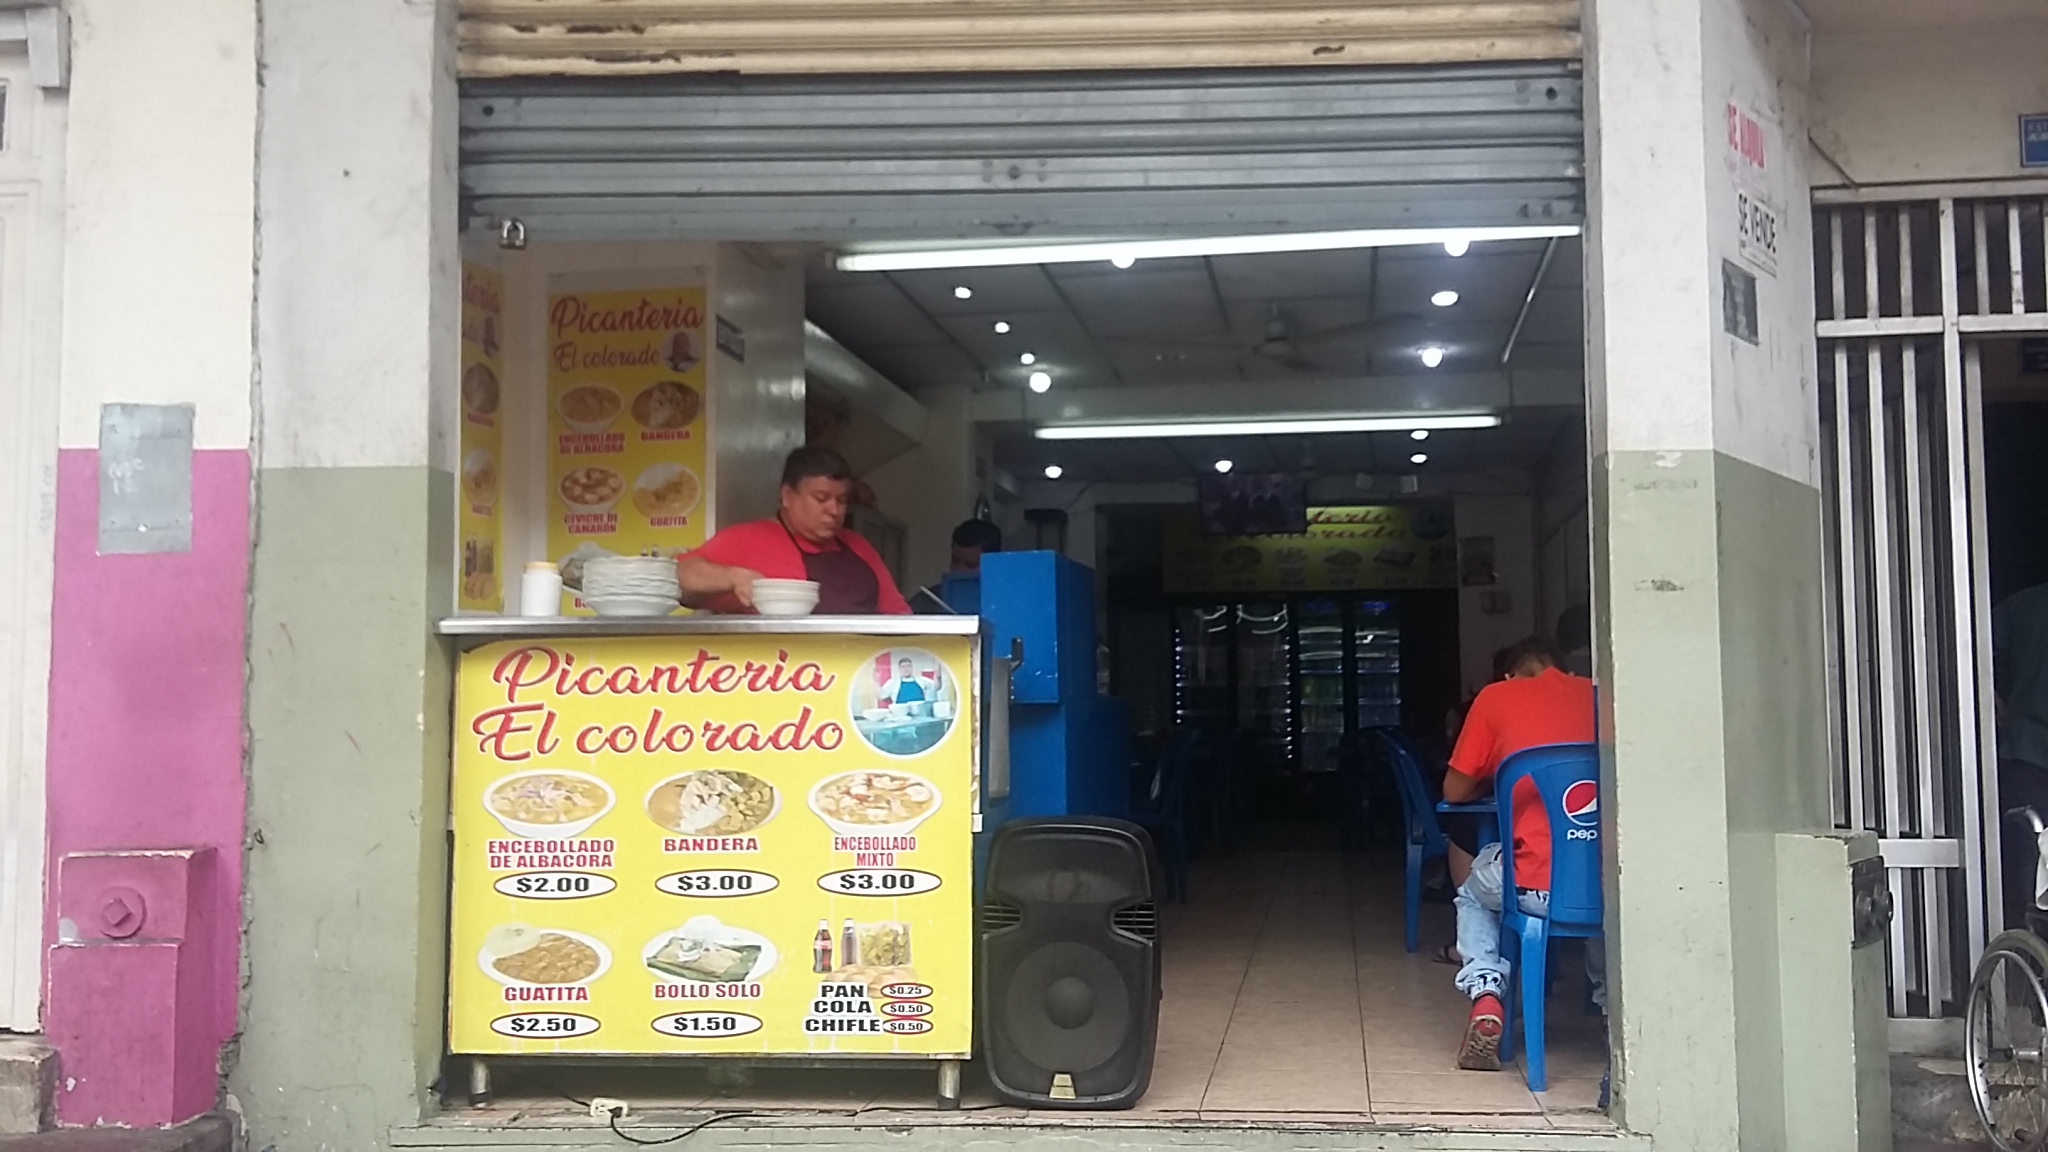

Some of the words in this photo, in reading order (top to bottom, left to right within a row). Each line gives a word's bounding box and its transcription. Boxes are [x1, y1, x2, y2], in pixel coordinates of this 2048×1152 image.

[1738, 193, 1749, 236] SE
[1750, 200, 1777, 254] VENDE
[551, 295, 703, 339] Picanteria
[553, 341, 578, 372] El
[582, 341, 661, 369] colorado
[492, 645, 836, 703] Picanteria
[471, 702, 560, 761] El
[576, 706, 844, 755] colorado
[487, 839, 615, 854] ENCEBOLLADO
[663, 837, 759, 851] BANDERA
[834, 836, 916, 851] ENCEBOLLADO
[489, 854, 514, 868] DE
[516, 854, 613, 868] ALBACORA
[856, 852, 895, 867] MIXTO
[516, 876, 590, 893] $2.00
[677, 873, 753, 892] $3.00
[840, 872, 915, 891] $3.00
[504, 986, 589, 1001] GUATITA
[654, 983, 710, 998] BOLLO
[715, 983, 761, 998] SOLO
[821, 985, 864, 998] PAN
[889, 986, 922, 995] $0.25
[813, 1000, 872, 1013] COLA
[889, 1004, 923, 1013] $0.50
[511, 1016, 577, 1034] $2.50
[674, 1015, 737, 1032] $1.50
[804, 1018, 881, 1032] CHIFLE
[889, 1022, 923, 1031] $0.50
